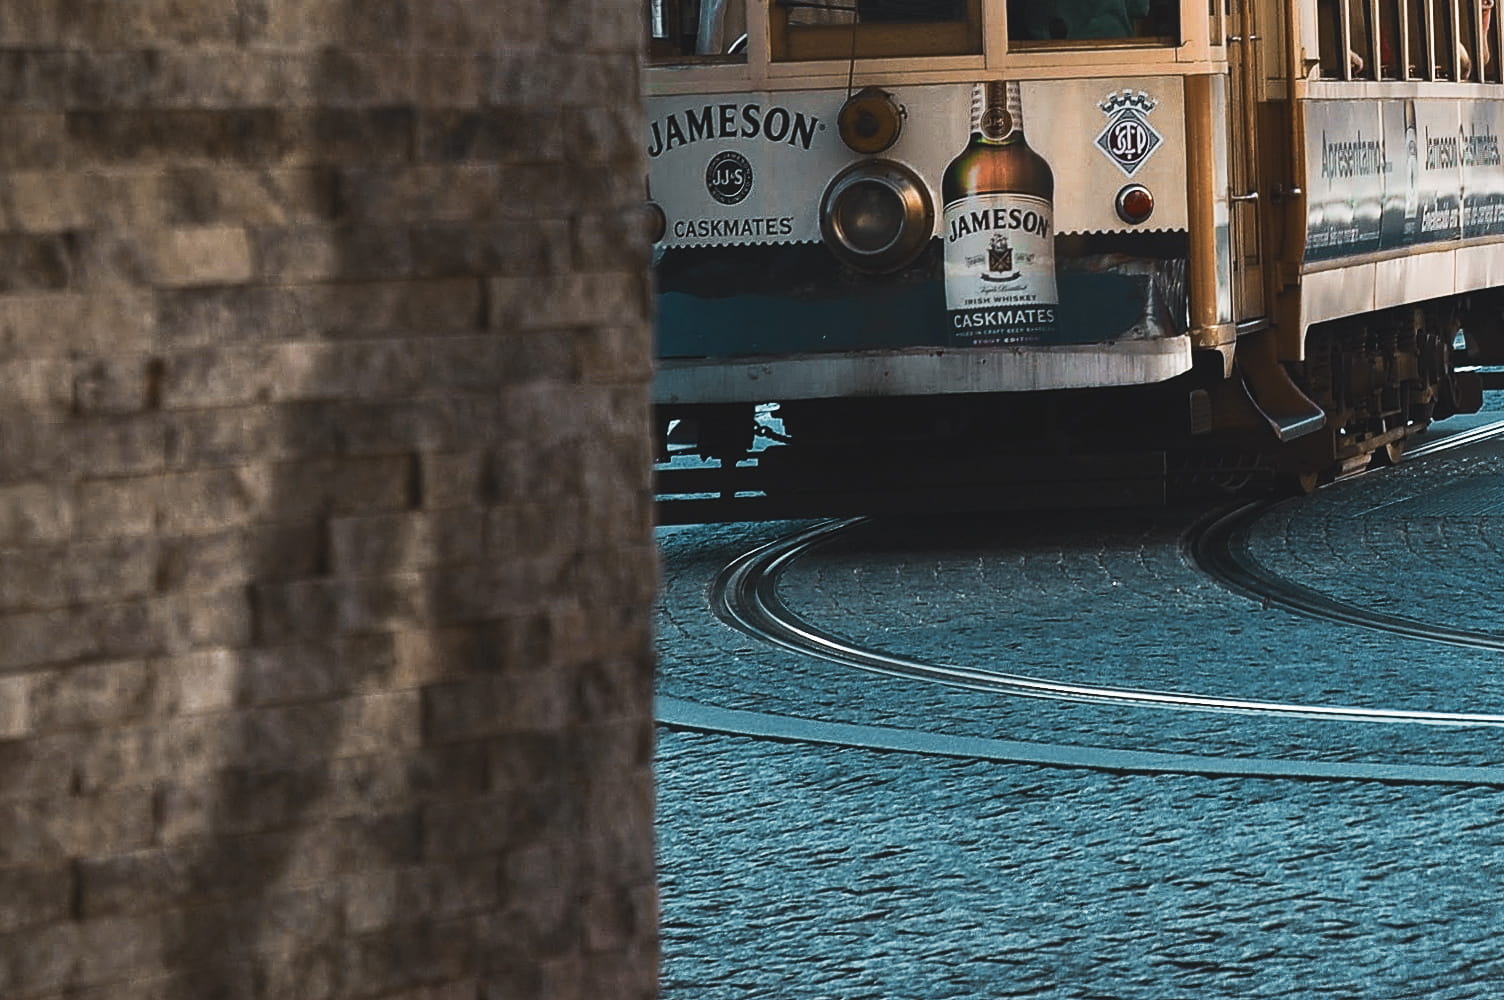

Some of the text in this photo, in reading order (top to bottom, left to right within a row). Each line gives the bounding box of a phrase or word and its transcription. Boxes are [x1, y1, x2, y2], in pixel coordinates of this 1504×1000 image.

[648, 103, 819, 158] JAMESON
[673, 217, 793, 238] CASKMATES
[949, 208, 1050, 243] JAMESON
[993, 294, 1037, 304] WHISKEY
[954, 309, 1056, 329] CASKMATES
